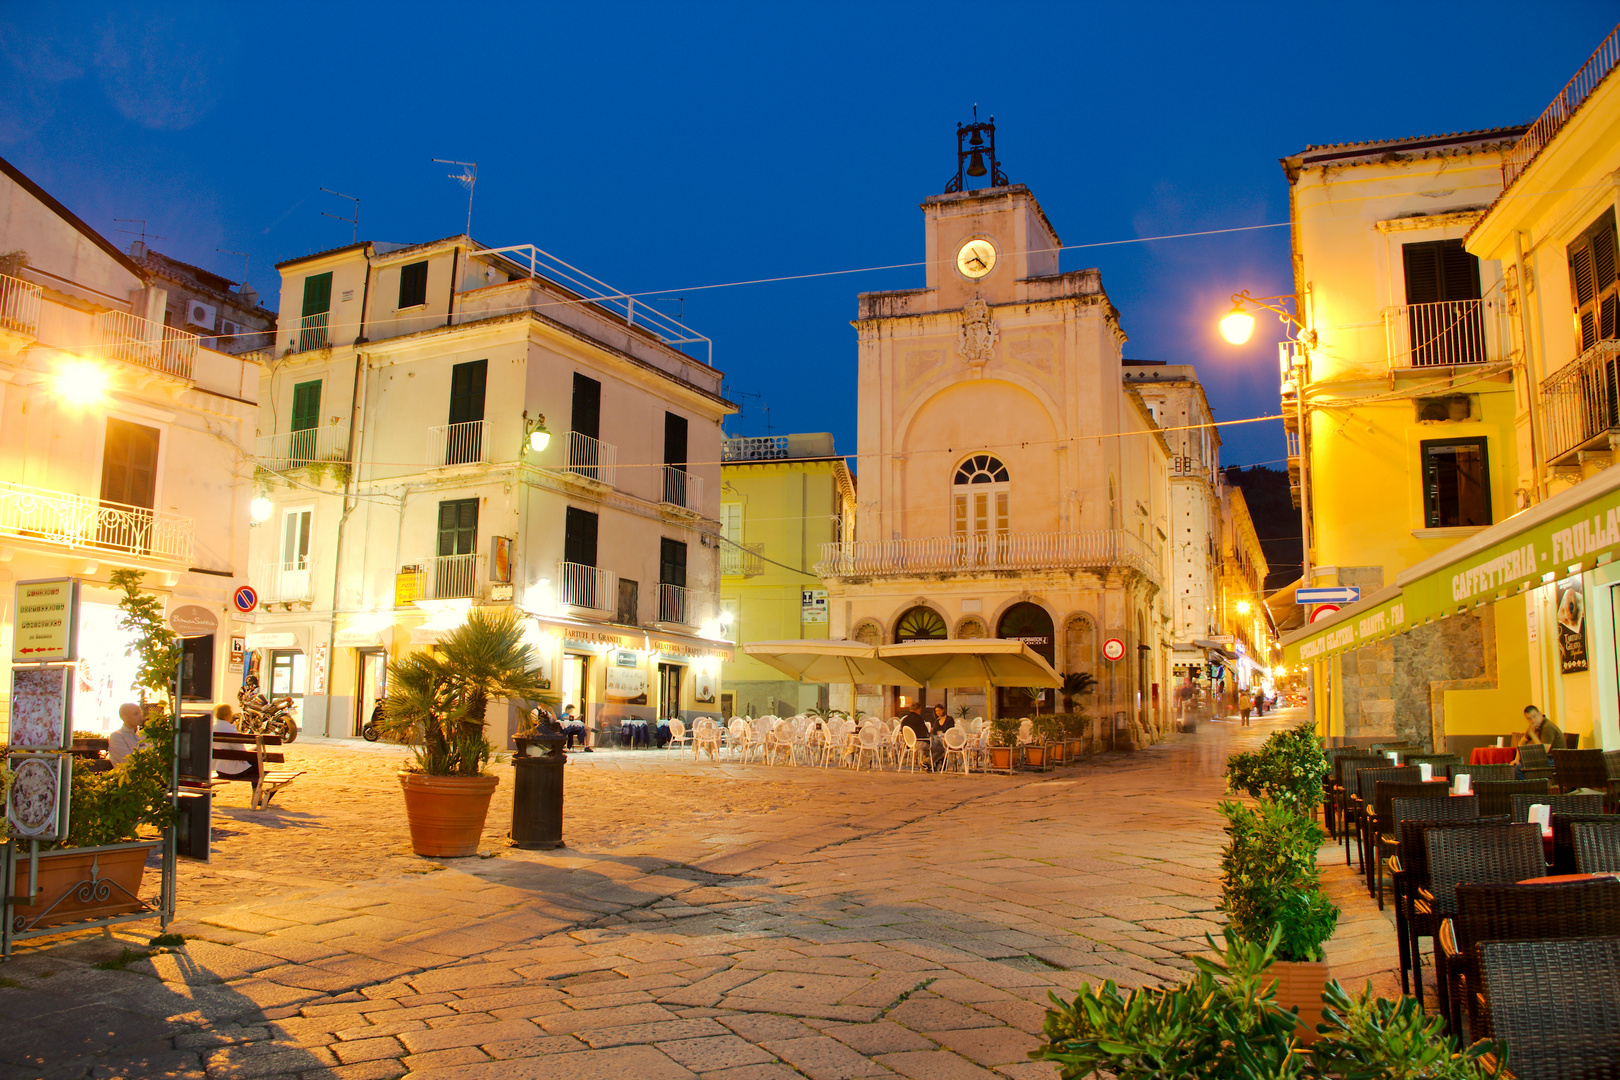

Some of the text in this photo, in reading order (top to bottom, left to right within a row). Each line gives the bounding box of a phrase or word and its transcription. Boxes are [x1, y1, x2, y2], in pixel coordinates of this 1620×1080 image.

[1452, 543, 1537, 601] CAFFETTERIA
[1551, 505, 1620, 565] FRULLA
[564, 628, 588, 639] TARTUFI
[598, 633, 622, 643] GRANITE
[654, 641, 681, 652] GELATERIA
